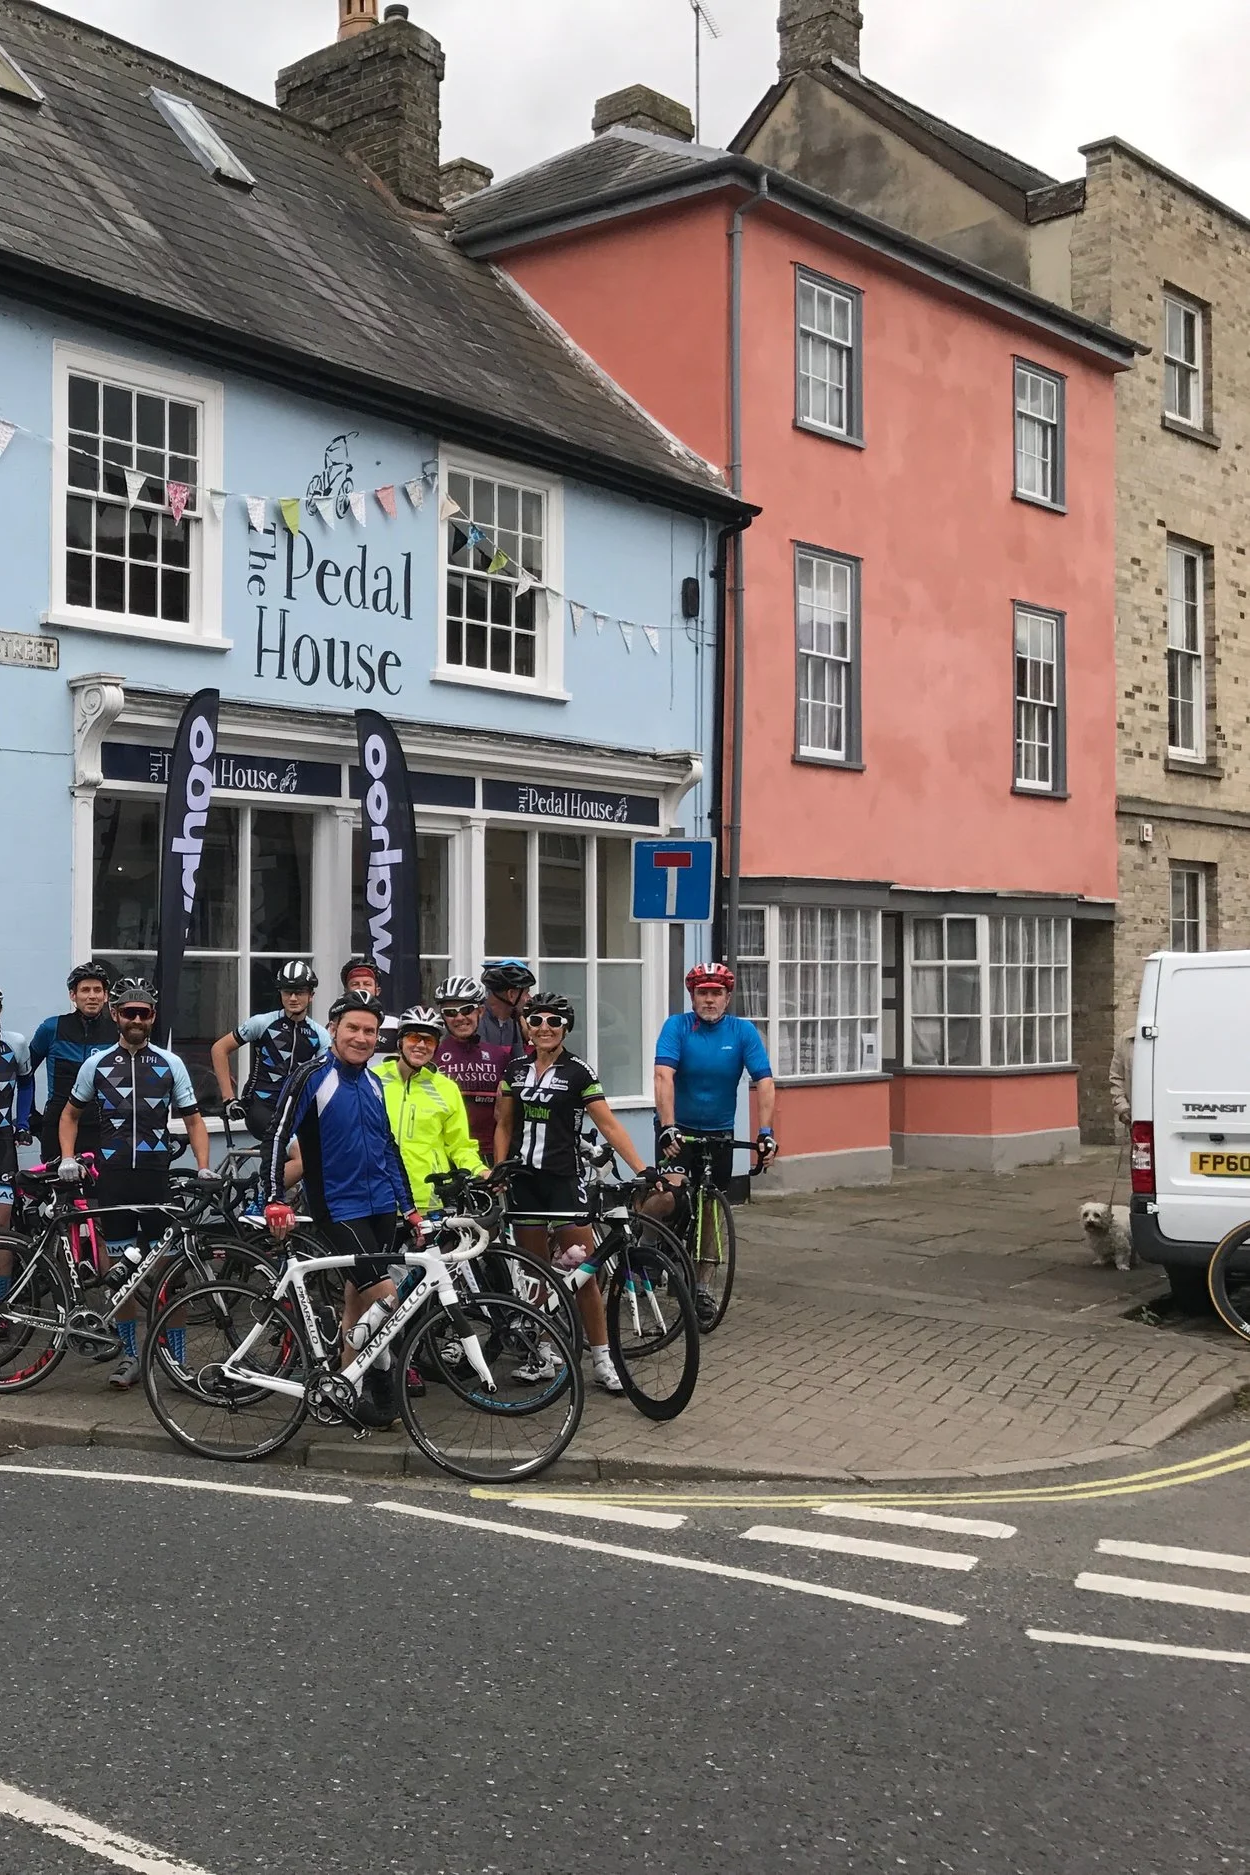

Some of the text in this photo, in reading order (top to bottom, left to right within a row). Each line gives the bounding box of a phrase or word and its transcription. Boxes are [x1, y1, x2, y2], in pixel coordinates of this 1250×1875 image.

[247, 521, 414, 621] The Pedal
[254, 604, 403, 696] House
[149, 750, 164, 782] The
[221, 758, 278, 791] House
[171, 715, 214, 939] ahoo
[517, 786, 614, 821] The Pedal House
[140, 1055, 158, 1064] TPH
[437, 1063, 497, 1074] CHIANTI
[519, 1087, 554, 1103] Liv
[1182, 1103, 1247, 1113] TRANSIT
[111, 1227, 174, 1307] PINARELLO
[295, 1286, 319, 1345] PINARELLO
[356, 1281, 428, 1369] PINARELLO
